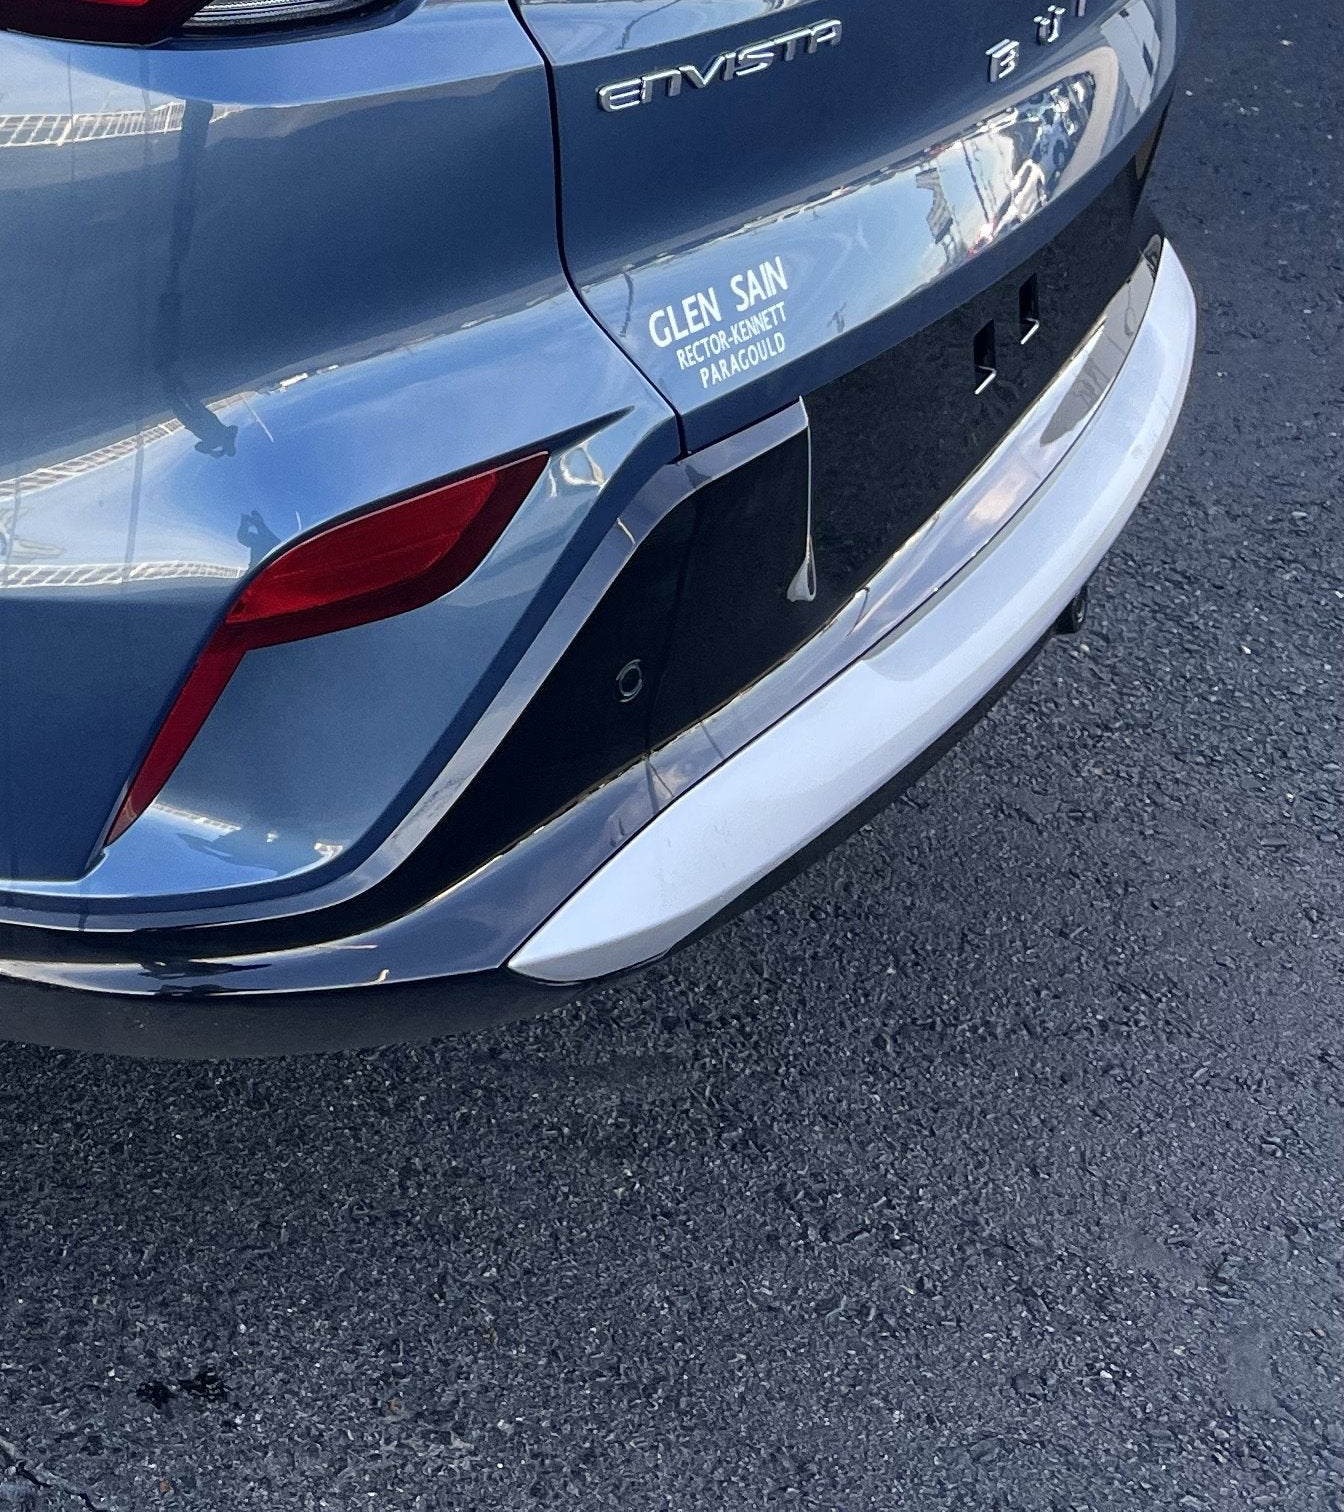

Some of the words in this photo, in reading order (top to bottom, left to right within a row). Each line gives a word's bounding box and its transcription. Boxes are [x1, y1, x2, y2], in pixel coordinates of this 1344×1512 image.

[597, 19, 842, 112] ENVISTA
[648, 287, 722, 348] GLEN
[730, 256, 789, 312] SAIN
[676, 301, 787, 370] RECTOR-KENNETT
[699, 332, 786, 389] PARAGOULD
